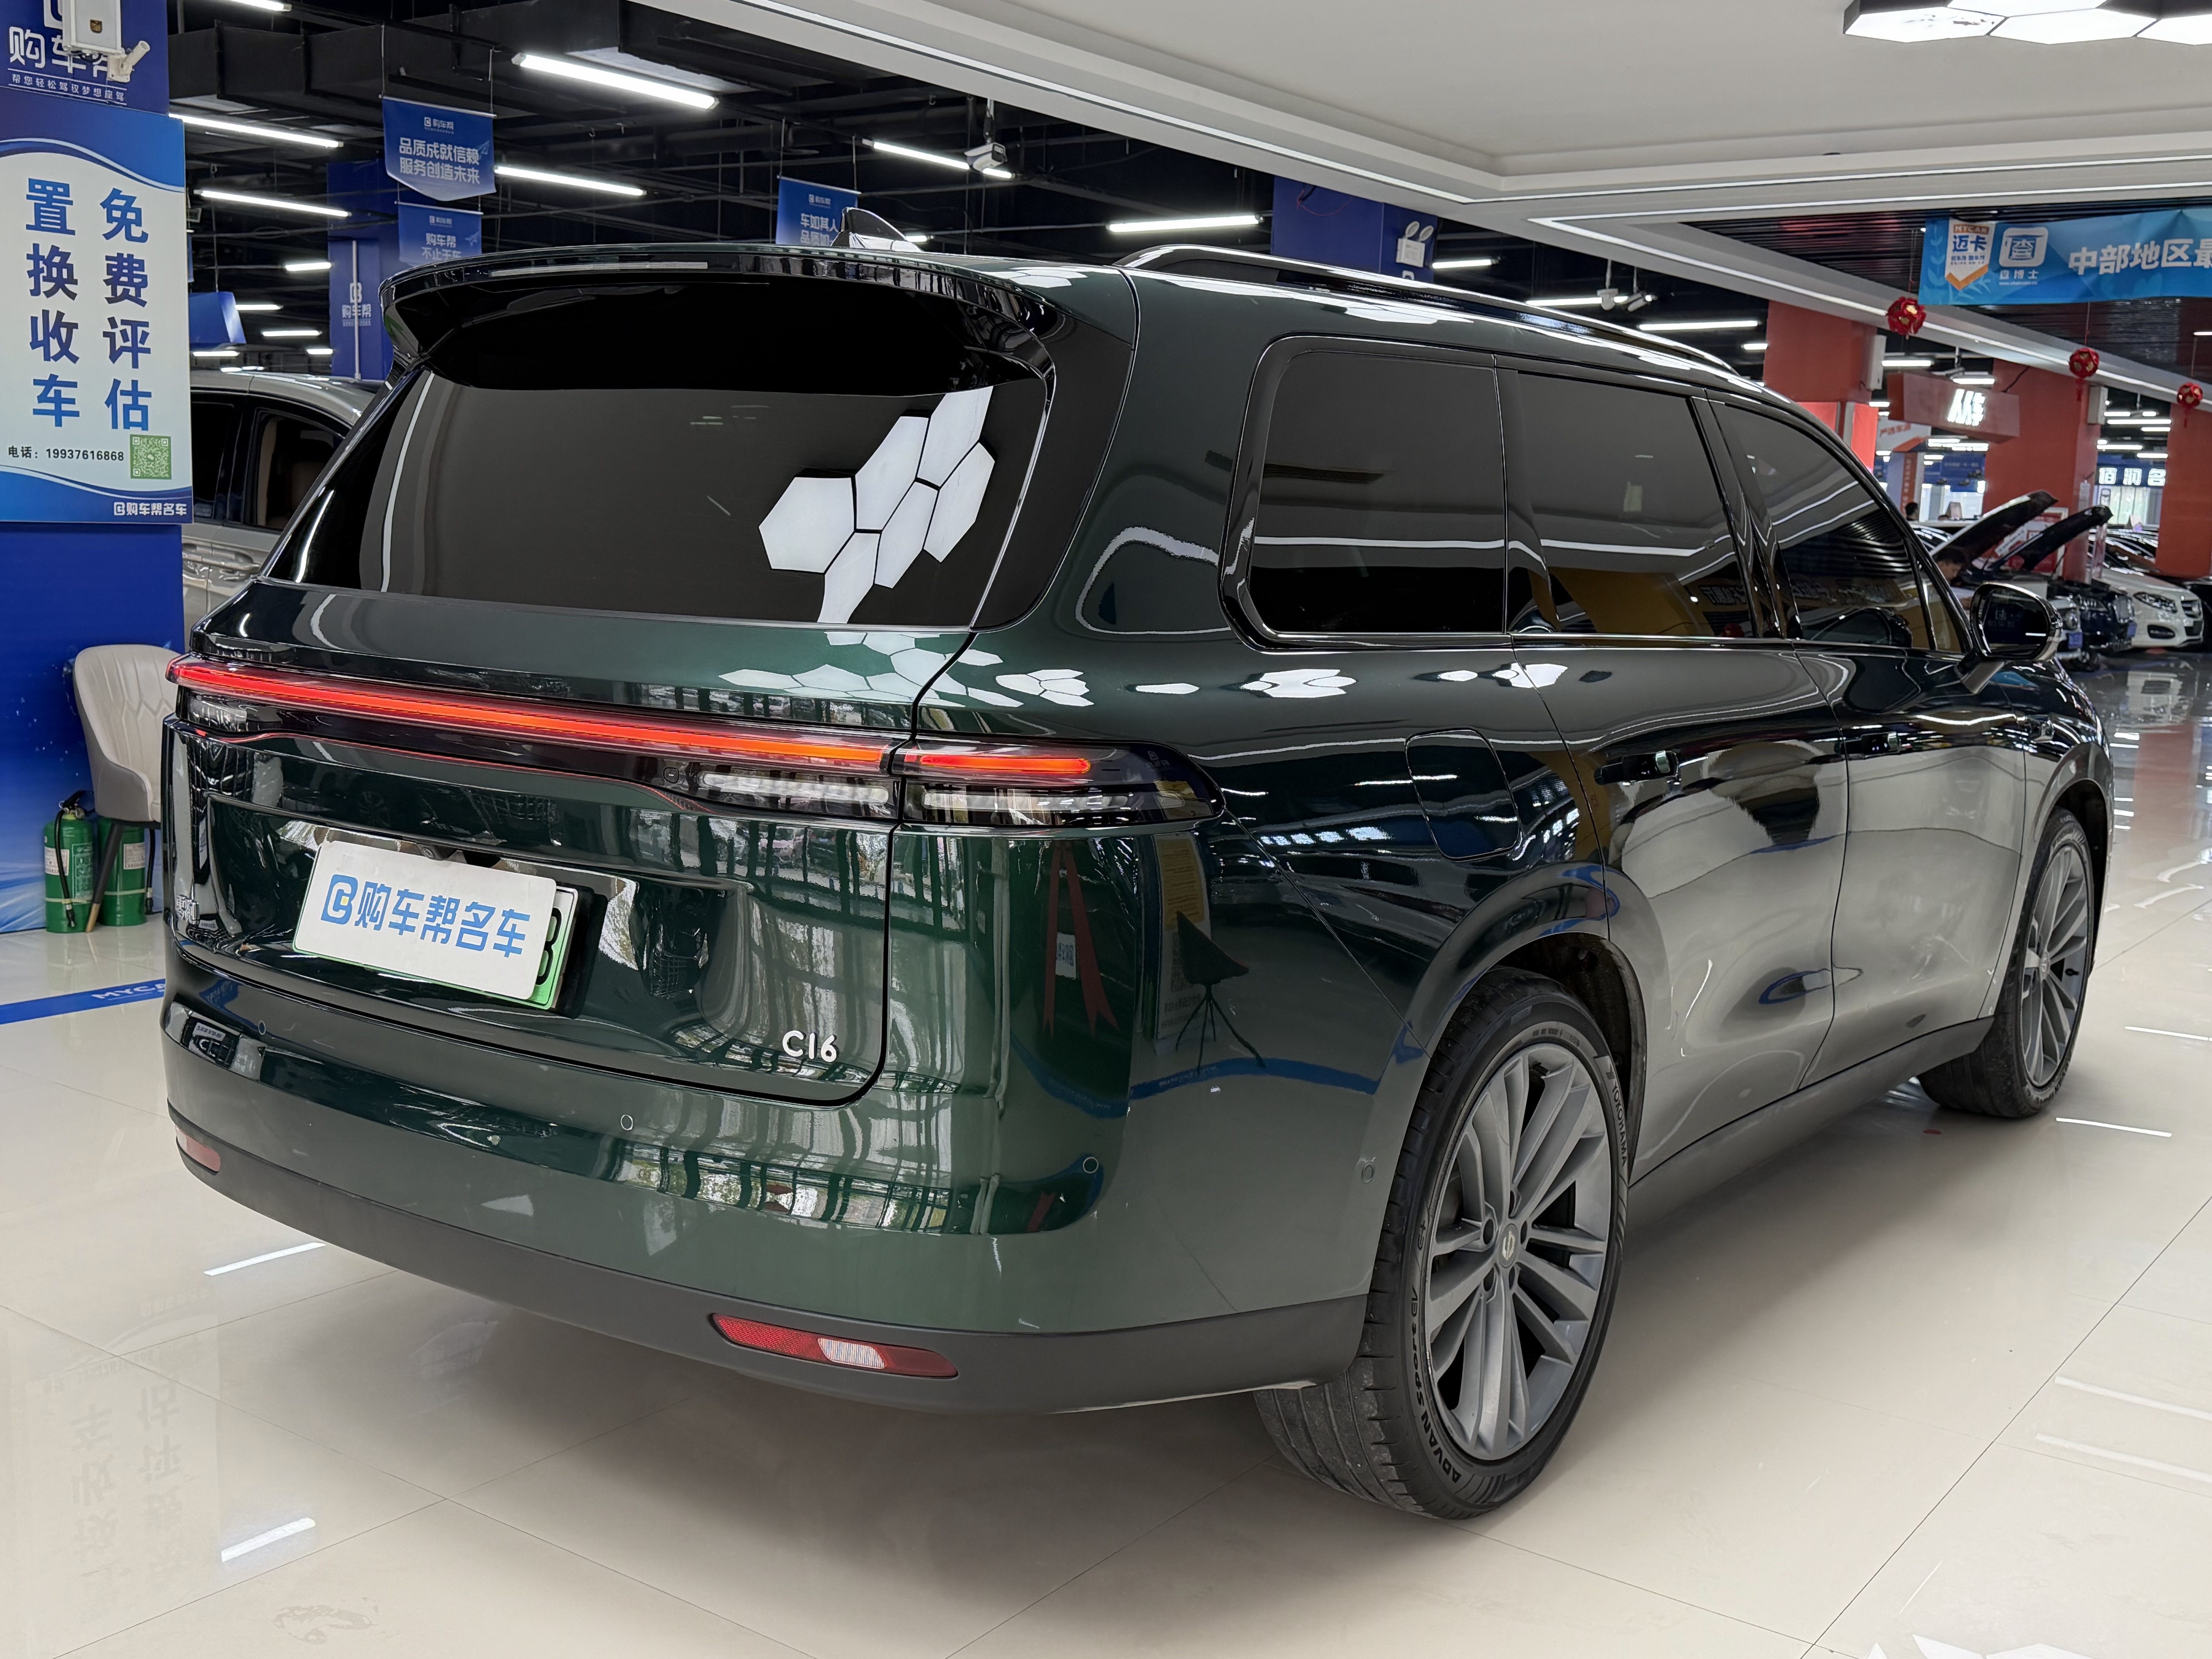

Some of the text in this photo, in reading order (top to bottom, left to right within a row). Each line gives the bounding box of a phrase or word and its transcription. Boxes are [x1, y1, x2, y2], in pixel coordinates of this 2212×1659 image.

[12, 74, 124, 101] 帮您轻松驾驭梦想座驾
[399, 137, 479, 165] 品质成就信赖
[400, 157, 480, 184] 服务创造未来
[426, 233, 456, 248] 购车帮
[1953, 235, 1987, 252] 迈卡
[26, 178, 80, 427] 置换收车
[100, 187, 152, 431] 免费评估
[46, 448, 124, 461] 19937616868
[126, 502, 187, 516] 购车帮名车
[354, 880, 531, 958] 购车帮名车
[782, 1030, 837, 1062] C16
[1612, 1081, 1627, 1167] YOKOHAMA
[1421, 1415, 1462, 1483] ADVAN
